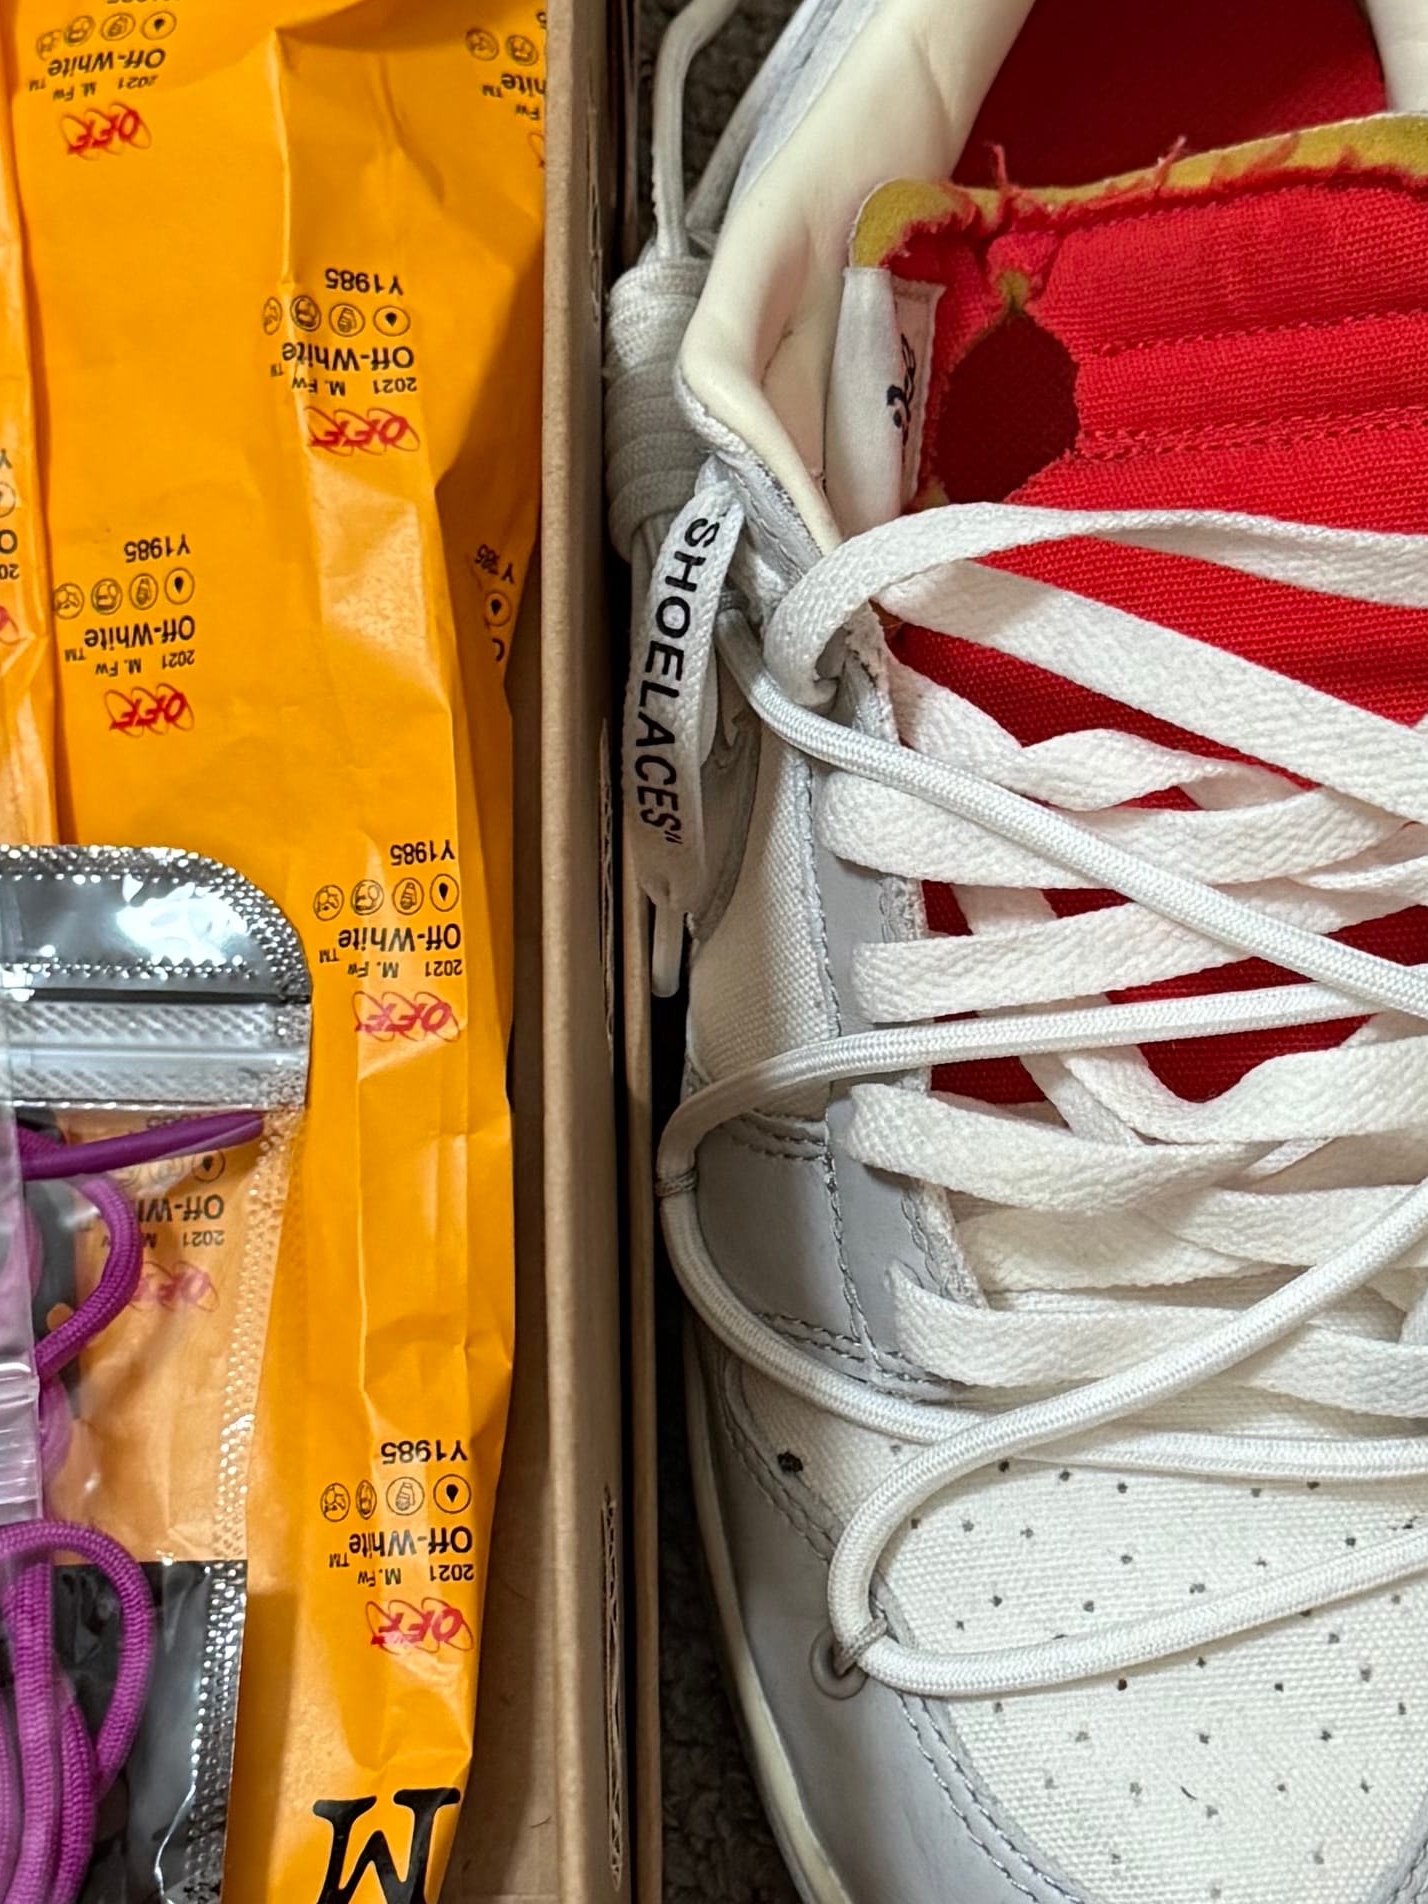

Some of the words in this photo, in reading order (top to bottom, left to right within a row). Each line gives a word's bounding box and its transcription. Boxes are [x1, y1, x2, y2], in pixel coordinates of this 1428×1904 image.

[48, 48, 165, 78] Off-White
[324, 268, 403, 295] Y1985
[282, 342, 414, 371] Off-White
[124, 535, 191, 563] Y1985
[85, 615, 196, 647] Off-White
[390, 840, 455, 866] Y1985
[338, 924, 461, 951] Off-White
[381, 1440, 468, 1465] Y1985
[349, 1525, 472, 1557] Off-White
